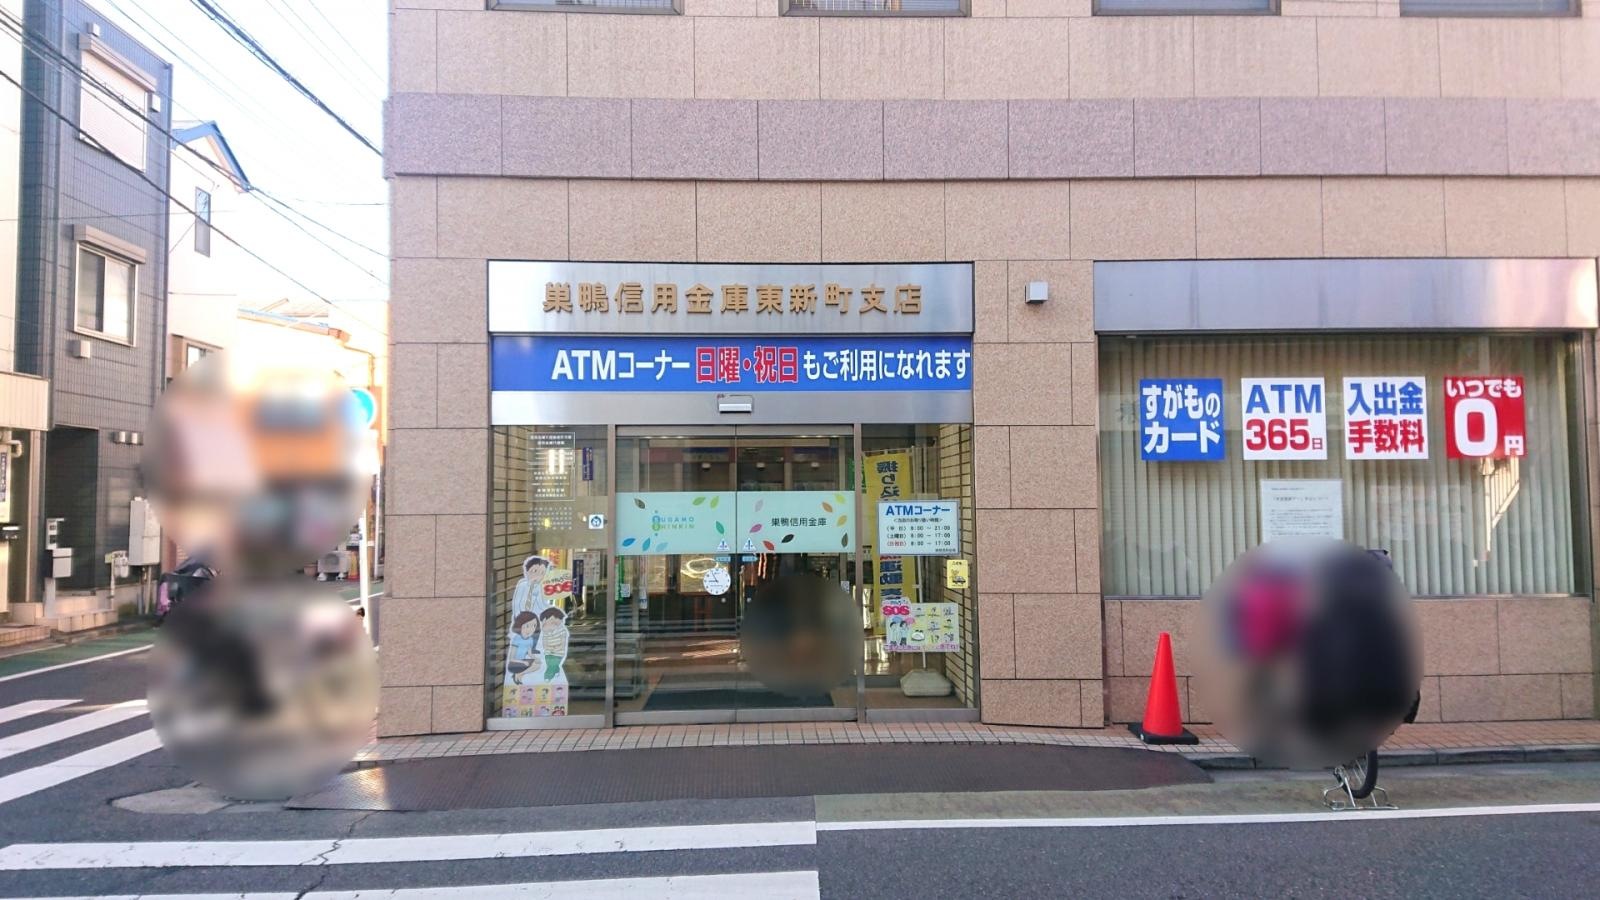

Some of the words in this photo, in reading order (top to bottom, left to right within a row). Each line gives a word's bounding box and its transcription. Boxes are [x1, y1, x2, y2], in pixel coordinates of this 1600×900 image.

[543, 281, 924, 315] 巣鴨信用金庫東新町支店
[1142, 384, 1221, 420] すがもの
[1245, 383, 1322, 414] ATM
[1347, 381, 1424, 416] 入出金
[1446, 379, 1522, 398] いつでも
[1144, 422, 1221, 454] カード
[1245, 418, 1324, 451] 365日
[1347, 418, 1425, 454] 手数料
[771, 516, 828, 527] 巣鴨信用金庫
[885, 505, 950, 515] ATMコーナー
[882, 604, 911, 616] SOS
